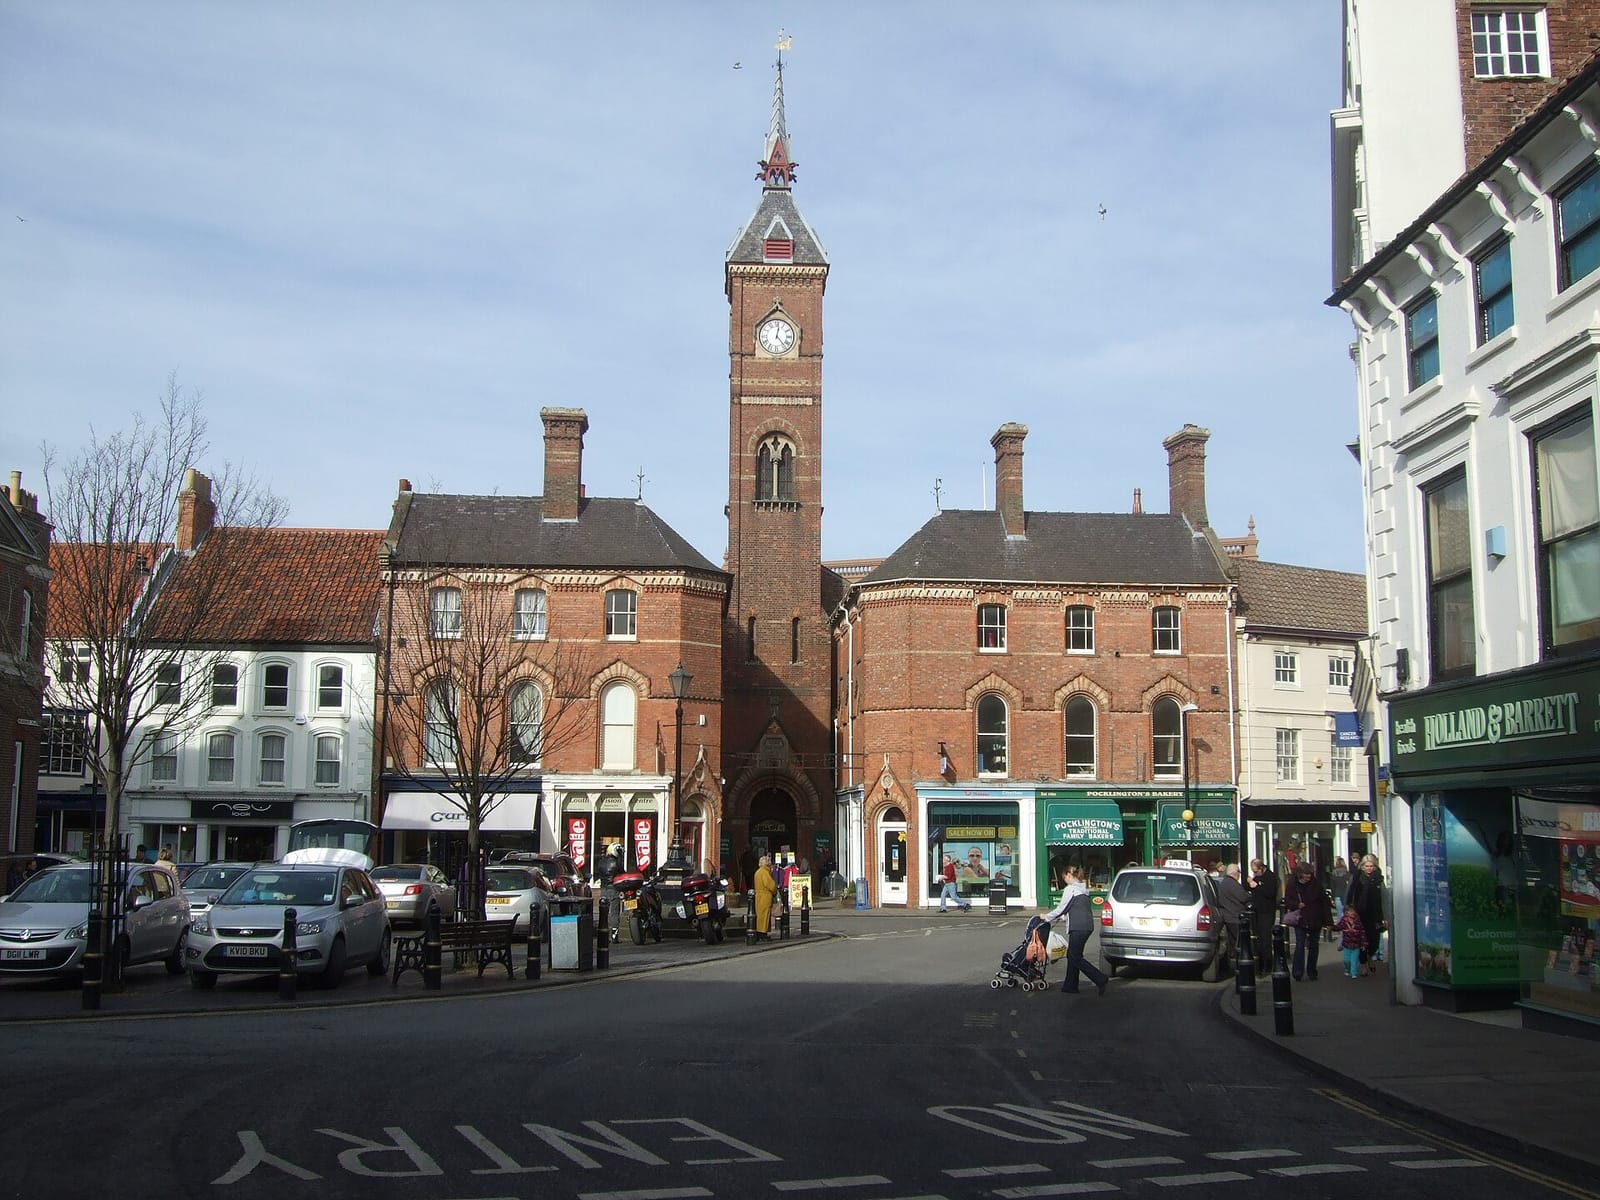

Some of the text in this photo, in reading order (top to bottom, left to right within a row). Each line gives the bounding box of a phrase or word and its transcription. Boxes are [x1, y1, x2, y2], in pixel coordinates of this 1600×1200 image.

[1395, 718, 1416, 735] health
[1424, 707, 1486, 751] HOLLAND
[1487, 704, 1503, 744] &
[1503, 692, 1580, 736] BARRETT
[1397, 738, 1416, 754] foods
[1331, 812, 1350, 821] EVE
[1353, 812, 1360, 821] &
[1055, 820, 1120, 831] POCKLINGTON'S
[1171, 820, 1235, 831] POCLINGTON'S
[949, 829, 967, 837] SALE
[968, 829, 982, 837] NOW
[983, 829, 994, 837] ON
[1467, 928, 1517, 941] Customer
[249, 946, 265, 955] BKU
[210, 1101, 1191, 1185] NO ENTRY
